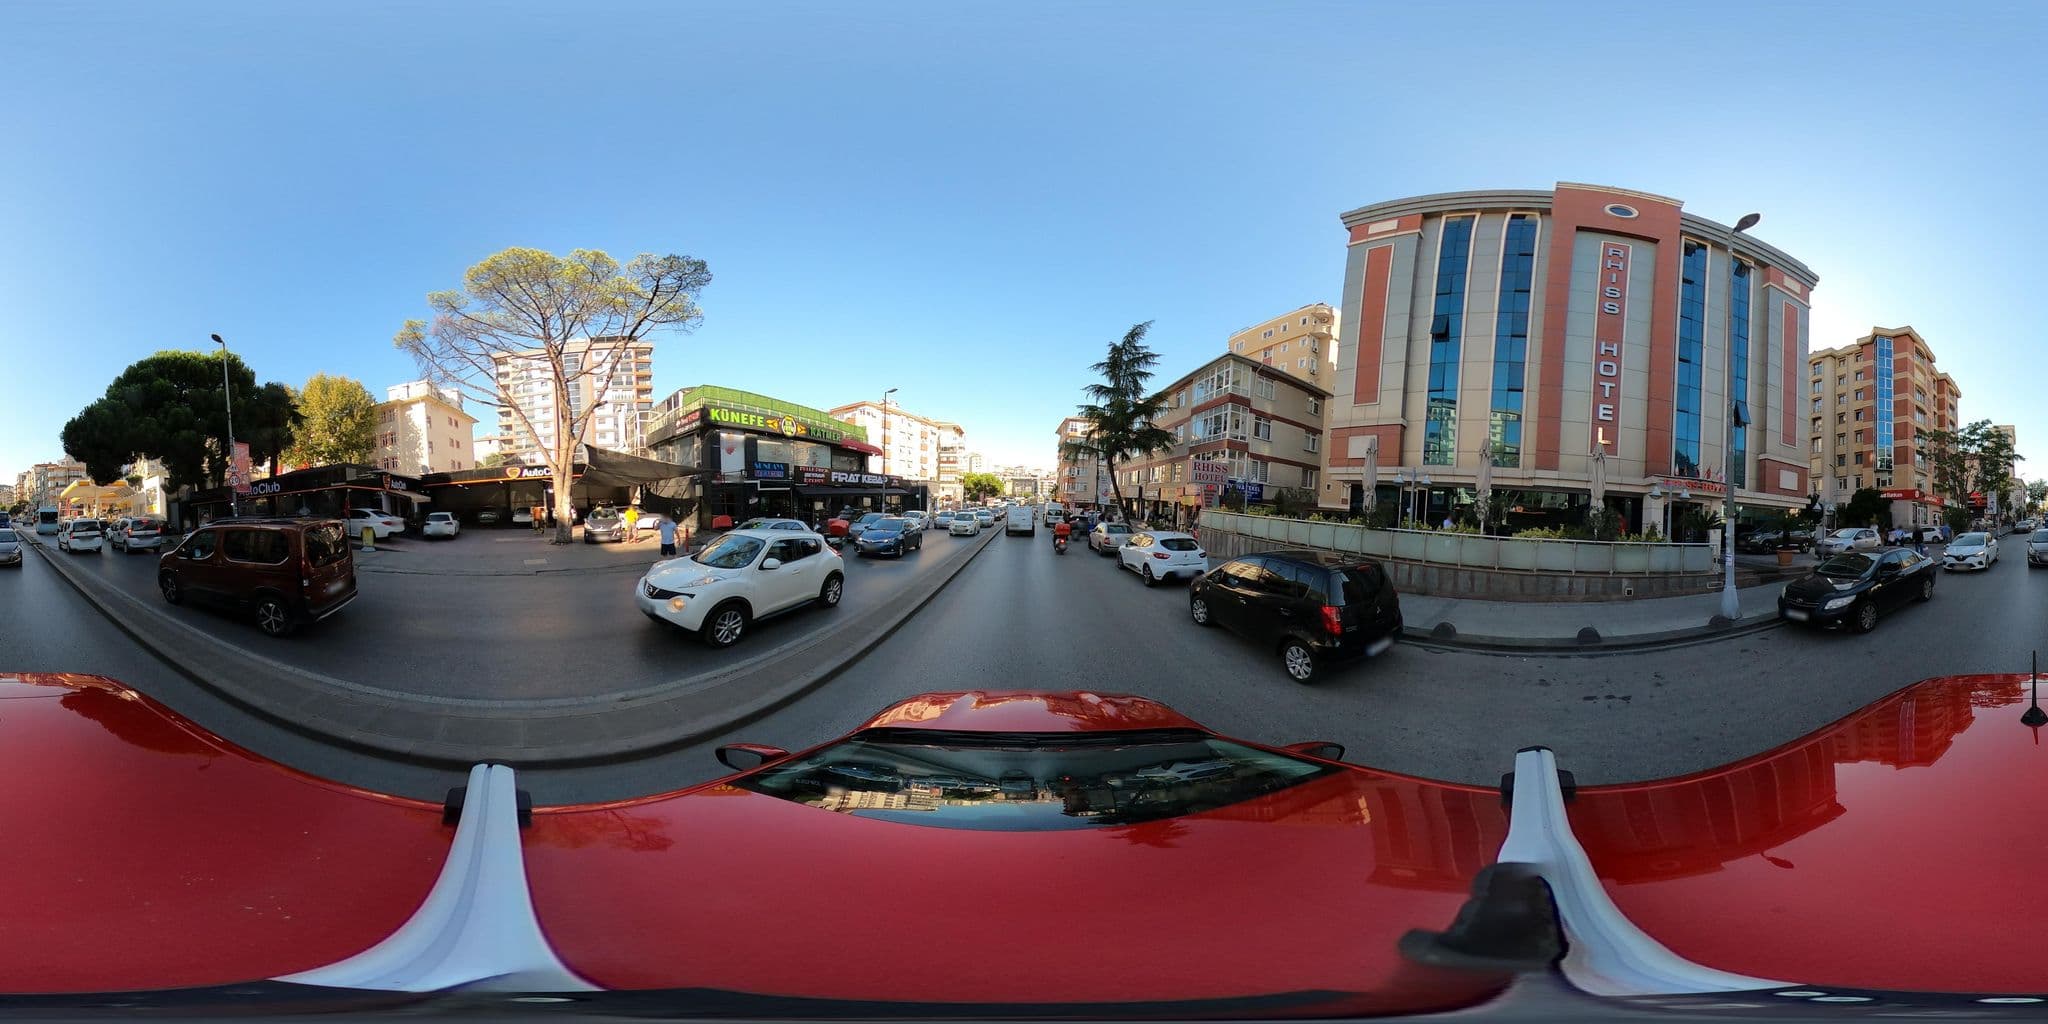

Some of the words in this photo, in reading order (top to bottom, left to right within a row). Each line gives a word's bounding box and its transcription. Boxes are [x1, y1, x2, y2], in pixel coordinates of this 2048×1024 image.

[1603, 247, 1624, 315] RHISS
[1598, 341, 1617, 445] HOTEL
[710, 409, 765, 427] KÜNEFE
[523, 467, 551, 477] AutoC
[1193, 461, 1229, 473] RHISS
